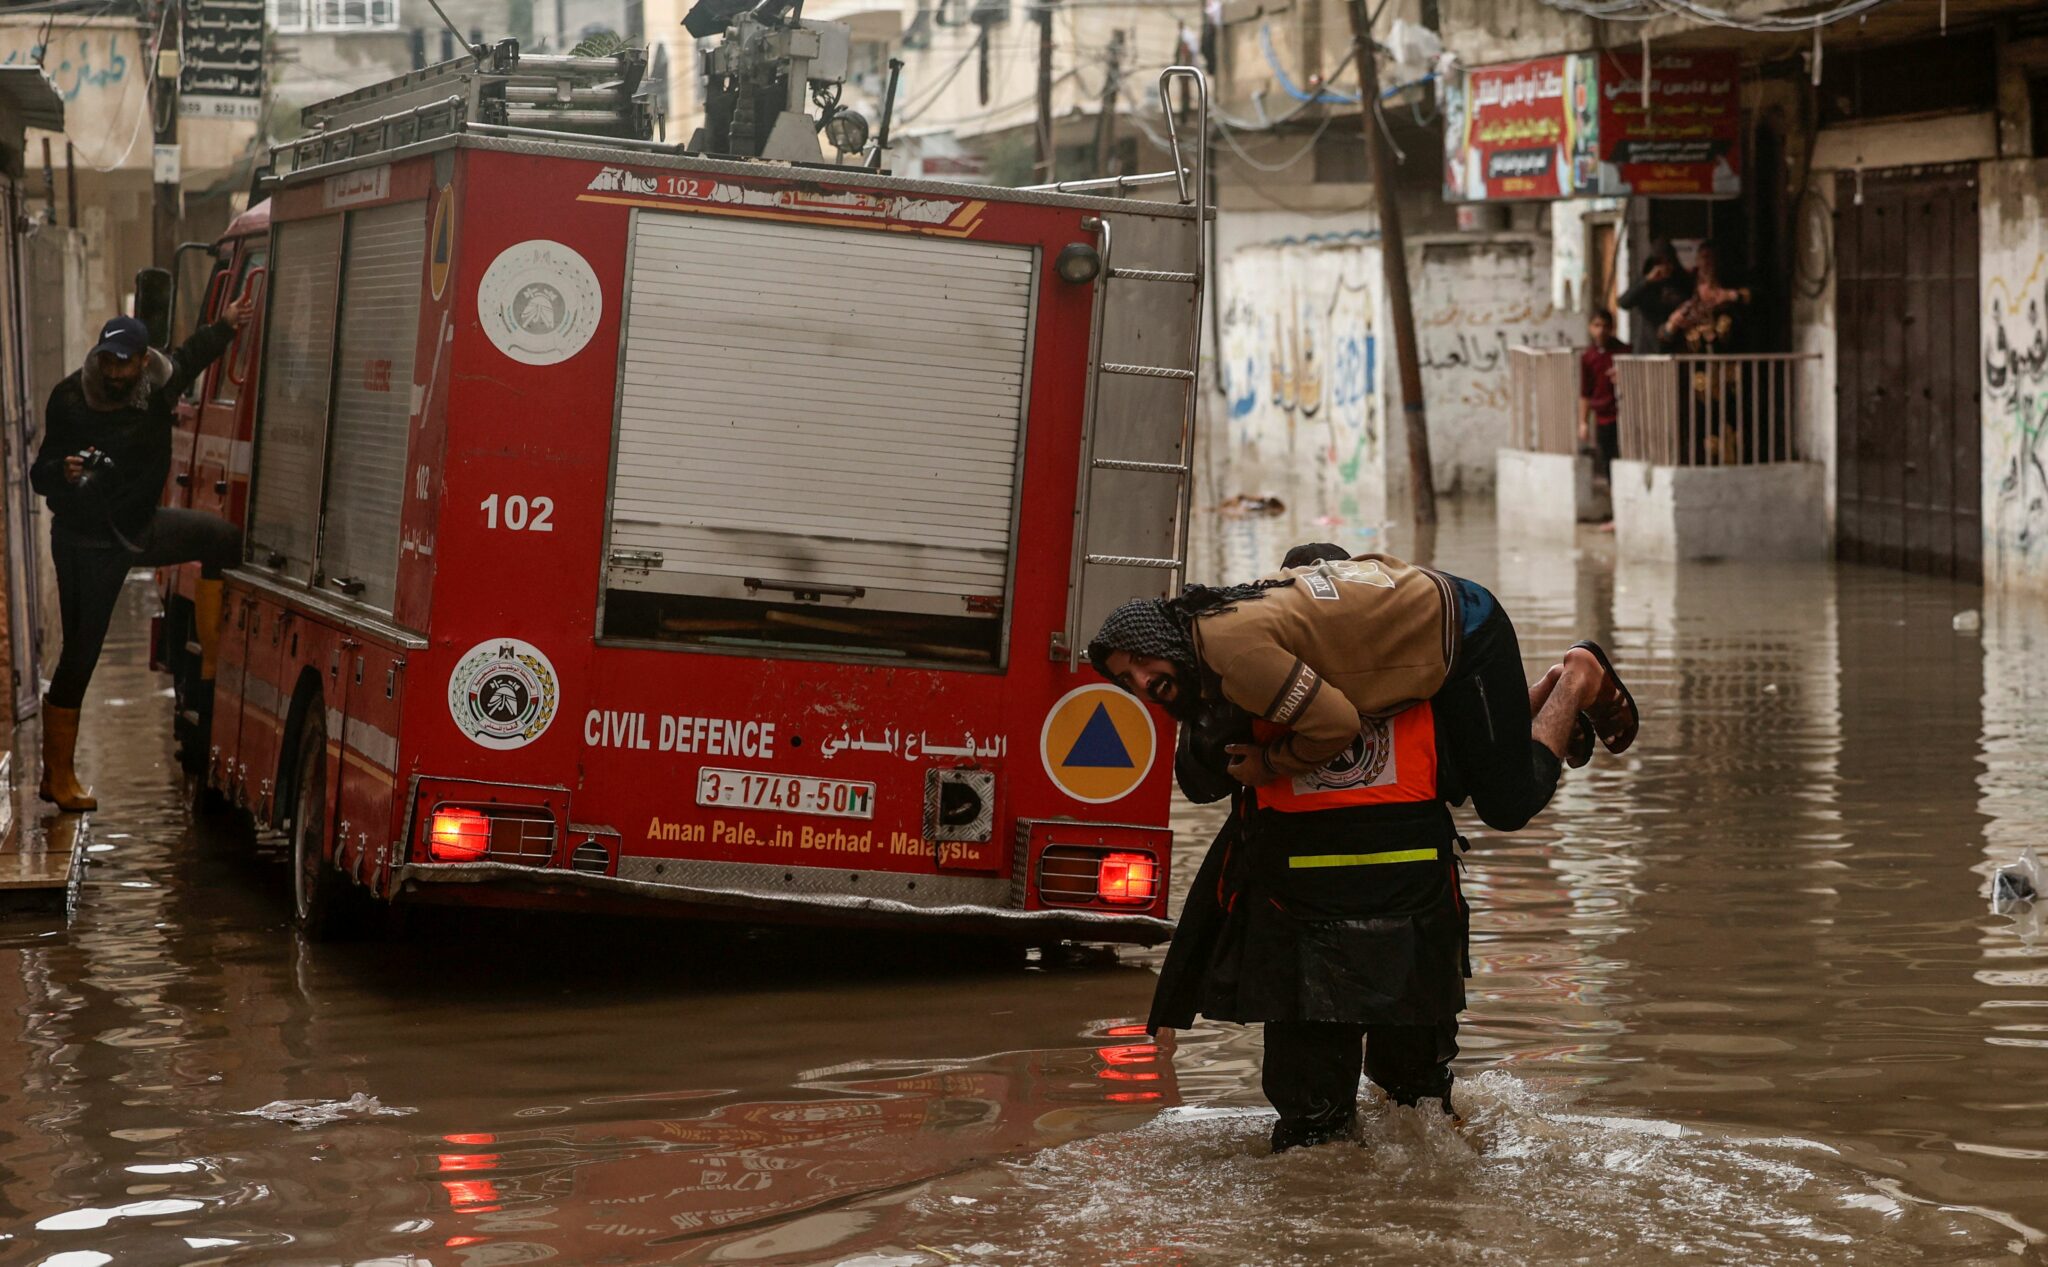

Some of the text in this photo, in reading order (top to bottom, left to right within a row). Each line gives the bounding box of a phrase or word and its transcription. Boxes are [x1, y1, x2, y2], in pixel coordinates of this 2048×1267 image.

[666, 177, 699, 196] 102
[415, 463, 430, 500] 102
[480, 493, 554, 532] 102
[1272, 679, 1310, 724] TRAINY
[584, 709, 776, 759] CIVIL DEFENCE
[820, 720, 1008, 762] الدفاع المدني
[647, 816, 706, 843] Aman
[712, 819, 794, 848] Palein
[800, 825, 872, 854] Berhad
